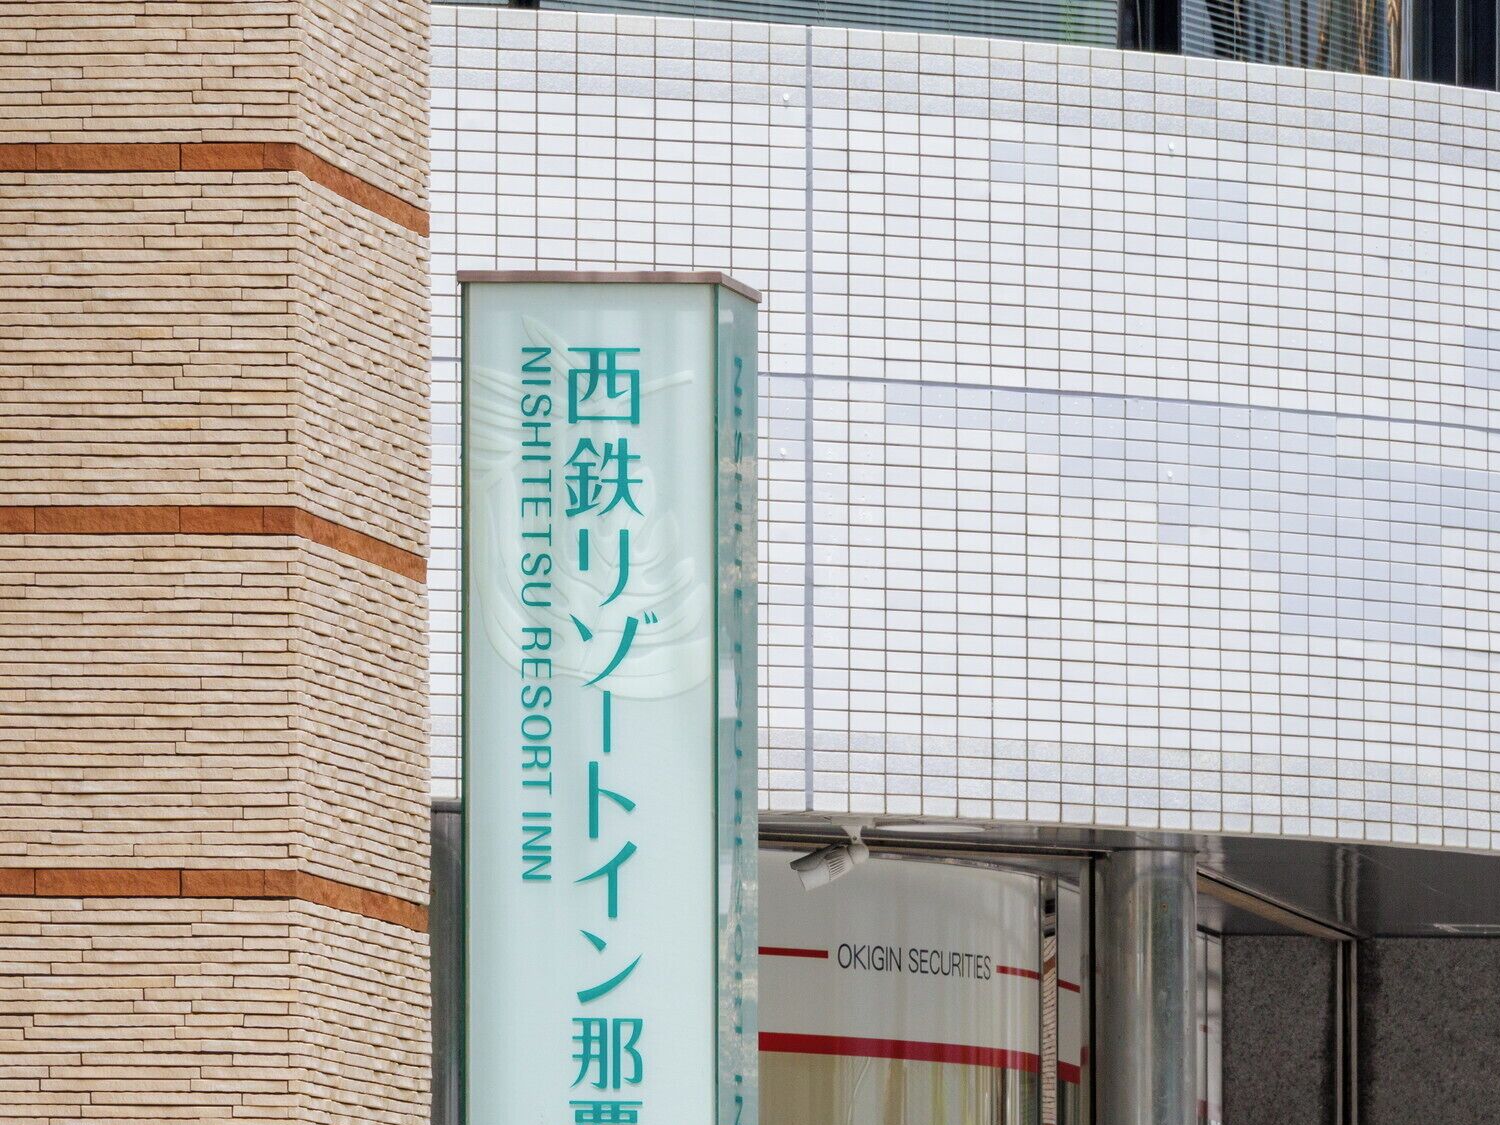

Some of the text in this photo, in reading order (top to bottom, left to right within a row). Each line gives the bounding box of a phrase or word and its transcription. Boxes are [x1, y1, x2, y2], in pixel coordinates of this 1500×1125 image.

[521, 346, 552, 881] NISHITETSU RESORT INN
[837, 943, 992, 981] OKIGIN SECURITIES
